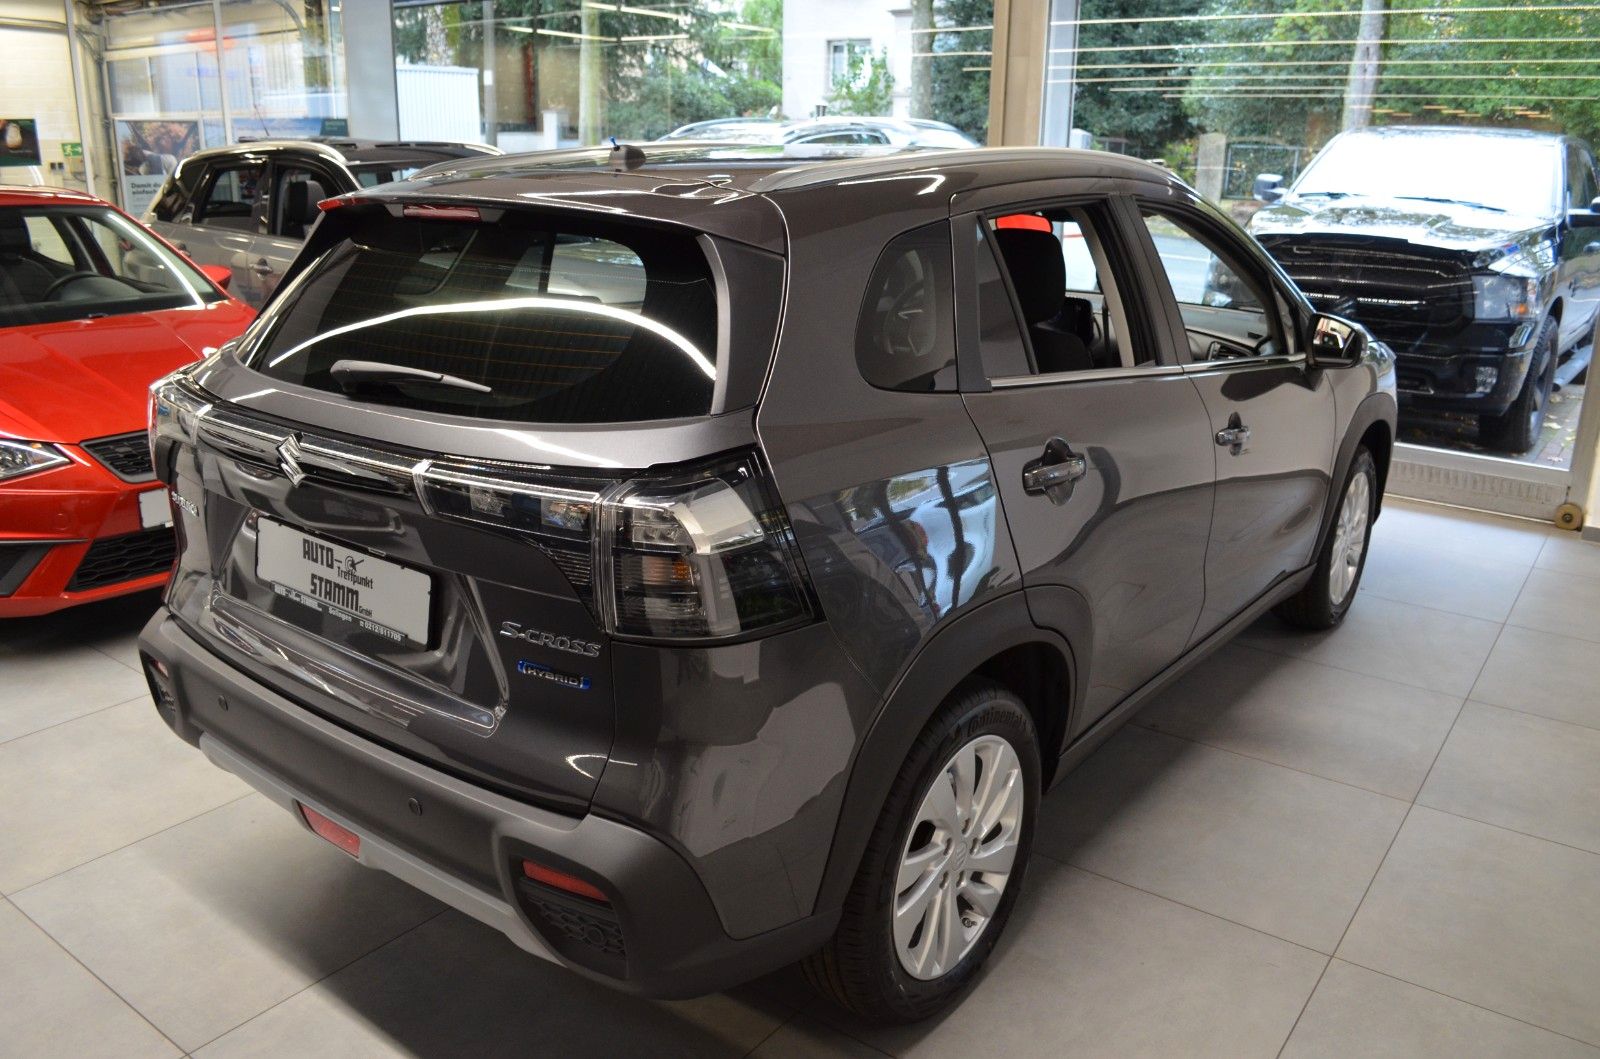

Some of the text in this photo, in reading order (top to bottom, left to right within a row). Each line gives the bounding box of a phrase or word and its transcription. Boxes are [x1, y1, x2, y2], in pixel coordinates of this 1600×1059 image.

[337, 566, 374, 590] Treffpunkt
[310, 573, 359, 612] STAMM
[359, 605, 373, 618] GmbH
[500, 621, 601, 658] S-CROSS
[525, 666, 581, 687] HYBRID
